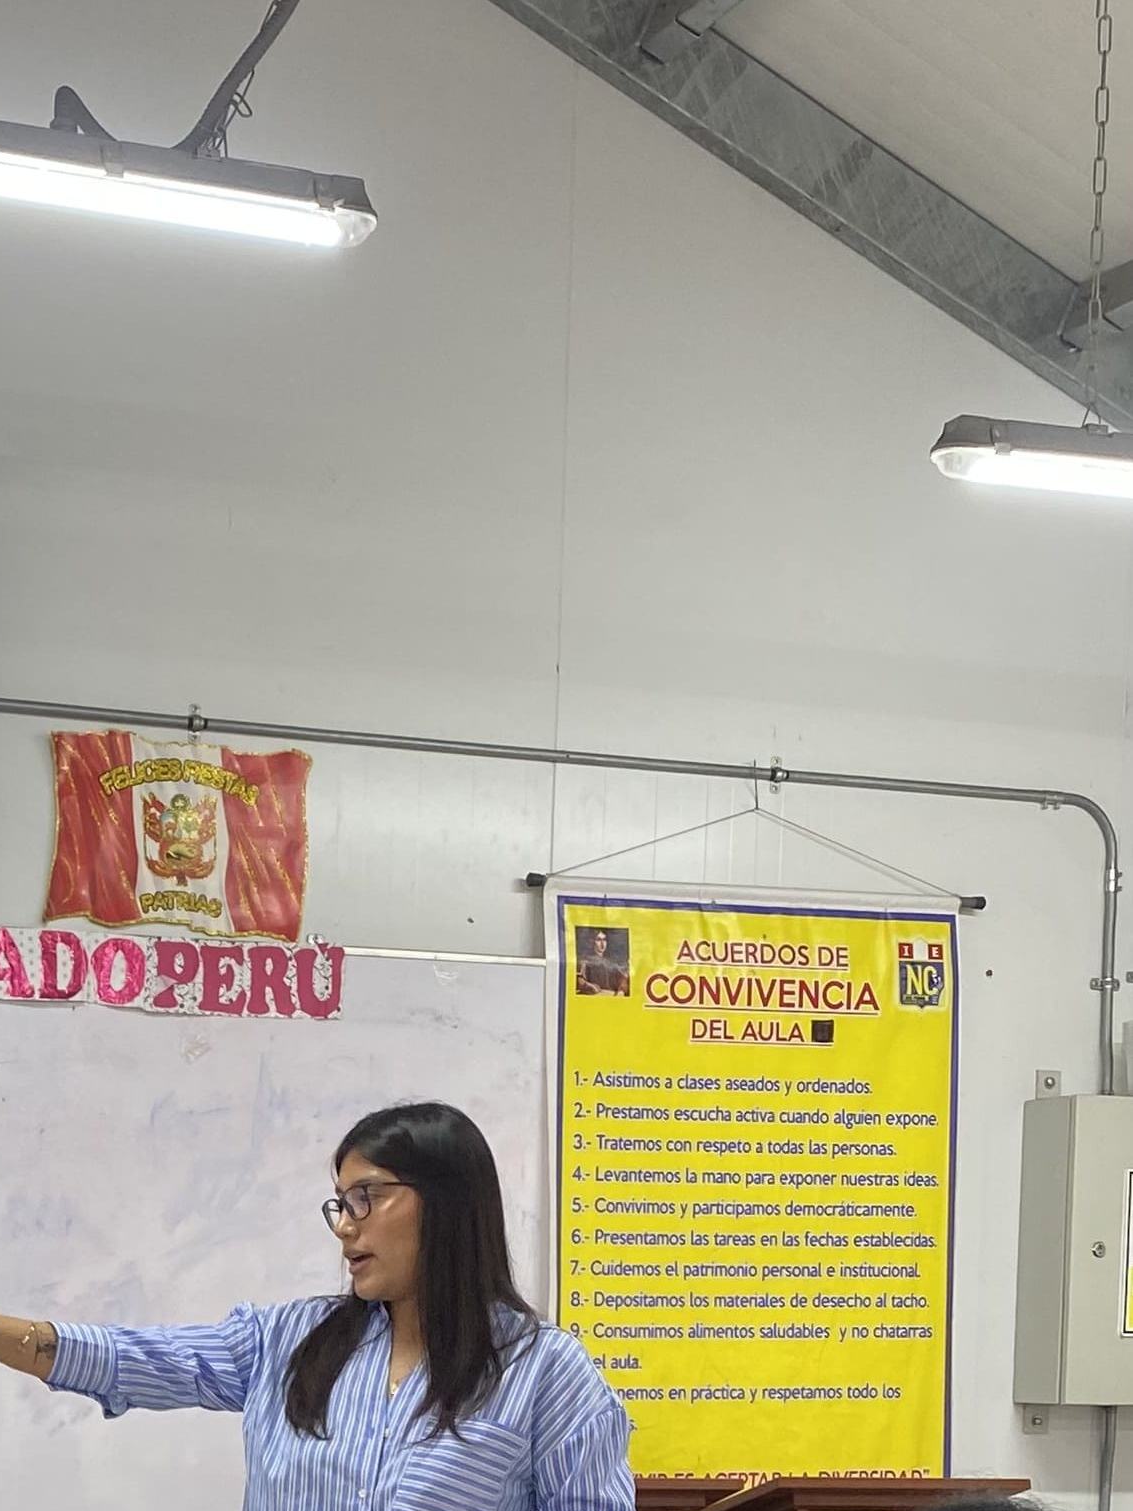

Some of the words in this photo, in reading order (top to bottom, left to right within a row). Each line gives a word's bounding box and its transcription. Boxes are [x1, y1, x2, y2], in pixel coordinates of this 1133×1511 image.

[99, 758, 183, 796] FELICES
[184, 760, 260, 807] FIESTAS
[140, 890, 222, 918] PATRIAS
[677, 939, 810, 967] ACUERDOS
[817, 946, 849, 968] DE
[644, 973, 881, 1012] CONVIVENCIA
[690, 1018, 734, 1041] DEL
[741, 1020, 805, 1043] AULA
[592, 1070, 661, 1090] Asistimos
[664, 1076, 673, 1090] a
[676, 1073, 722, 1091] clases
[724, 1075, 781, 1093] aseados
[784, 1080, 793, 1097] y
[796, 1077, 873, 1095] ordenados.
[596, 1102, 670, 1121] Prestamos
[673, 1105, 732, 1122] escucha
[735, 1109, 776, 1123] activa
[778, 1108, 830, 1125] cuando
[833, 1108, 882, 1130] alguien
[885, 1113, 939, 1130] expone.
[595, 1133, 663, 1152] Tratemos
[665, 1139, 692, 1153] con
[696, 1140, 752, 1157] respeto
[755, 1141, 764, 1154] a
[767, 1138, 805, 1155] todas
[808, 1138, 828, 1155] las
[831, 1143, 897, 1160] personas.
[595, 1165, 682, 1184] Levantemos
[685, 1167, 698, 1184] la
[701, 1171, 742, 1185] mano
[745, 1172, 776, 1189] para
[779, 1173, 837, 1190] exponer
[840, 1173, 900, 1188] nuestras
[903, 1170, 940, 1188] ideas.
[594, 1197, 676, 1215] Convivimos
[679, 1202, 689, 1219] y
[692, 1198, 782, 1220] participamos
[594, 1228, 687, 1246] Presentamos
[690, 1229, 710, 1247] las
[713, 1232, 756, 1247] tareas
[759, 1234, 778, 1247] en
[781, 1230, 801, 1248] las
[803, 1230, 849, 1248] fechas
[853, 1231, 938, 1248] establecidas.
[590, 1259, 662, 1277] Cuidemos
[664, 1260, 680, 1278] el
[683, 1261, 758, 1281] patrimonio
[761, 1261, 823, 1282] personal
[825, 1265, 836, 1278] e
[839, 1261, 921, 1278] institucional.
[593, 1290, 686, 1312] Depositamos
[689, 1291, 710, 1308] los
[713, 1292, 786, 1309] materiales
[789, 1292, 808, 1309] de
[811, 1292, 872, 1309] desecho
[874, 1292, 888, 1309] al
[890, 1292, 930, 1309] tacho.
[592, 1322, 684, 1339] Consumimos
[687, 1322, 756, 1339] alimentos
[759, 1322, 831, 1339] saludables
[839, 1326, 848, 1343] y
[851, 1326, 870, 1339] no
[872, 1322, 933, 1339] chatarras
[610, 1353, 643, 1370] aula.
[612, 1387, 665, 1401] nemos
[667, 1388, 687, 1401] en
[690, 1383, 746, 1405] práctica
[749, 1388, 758, 1404] y
[761, 1386, 843, 1404] respetamos
[846, 1382, 879, 1400] todo
[882, 1383, 902, 1399] los
